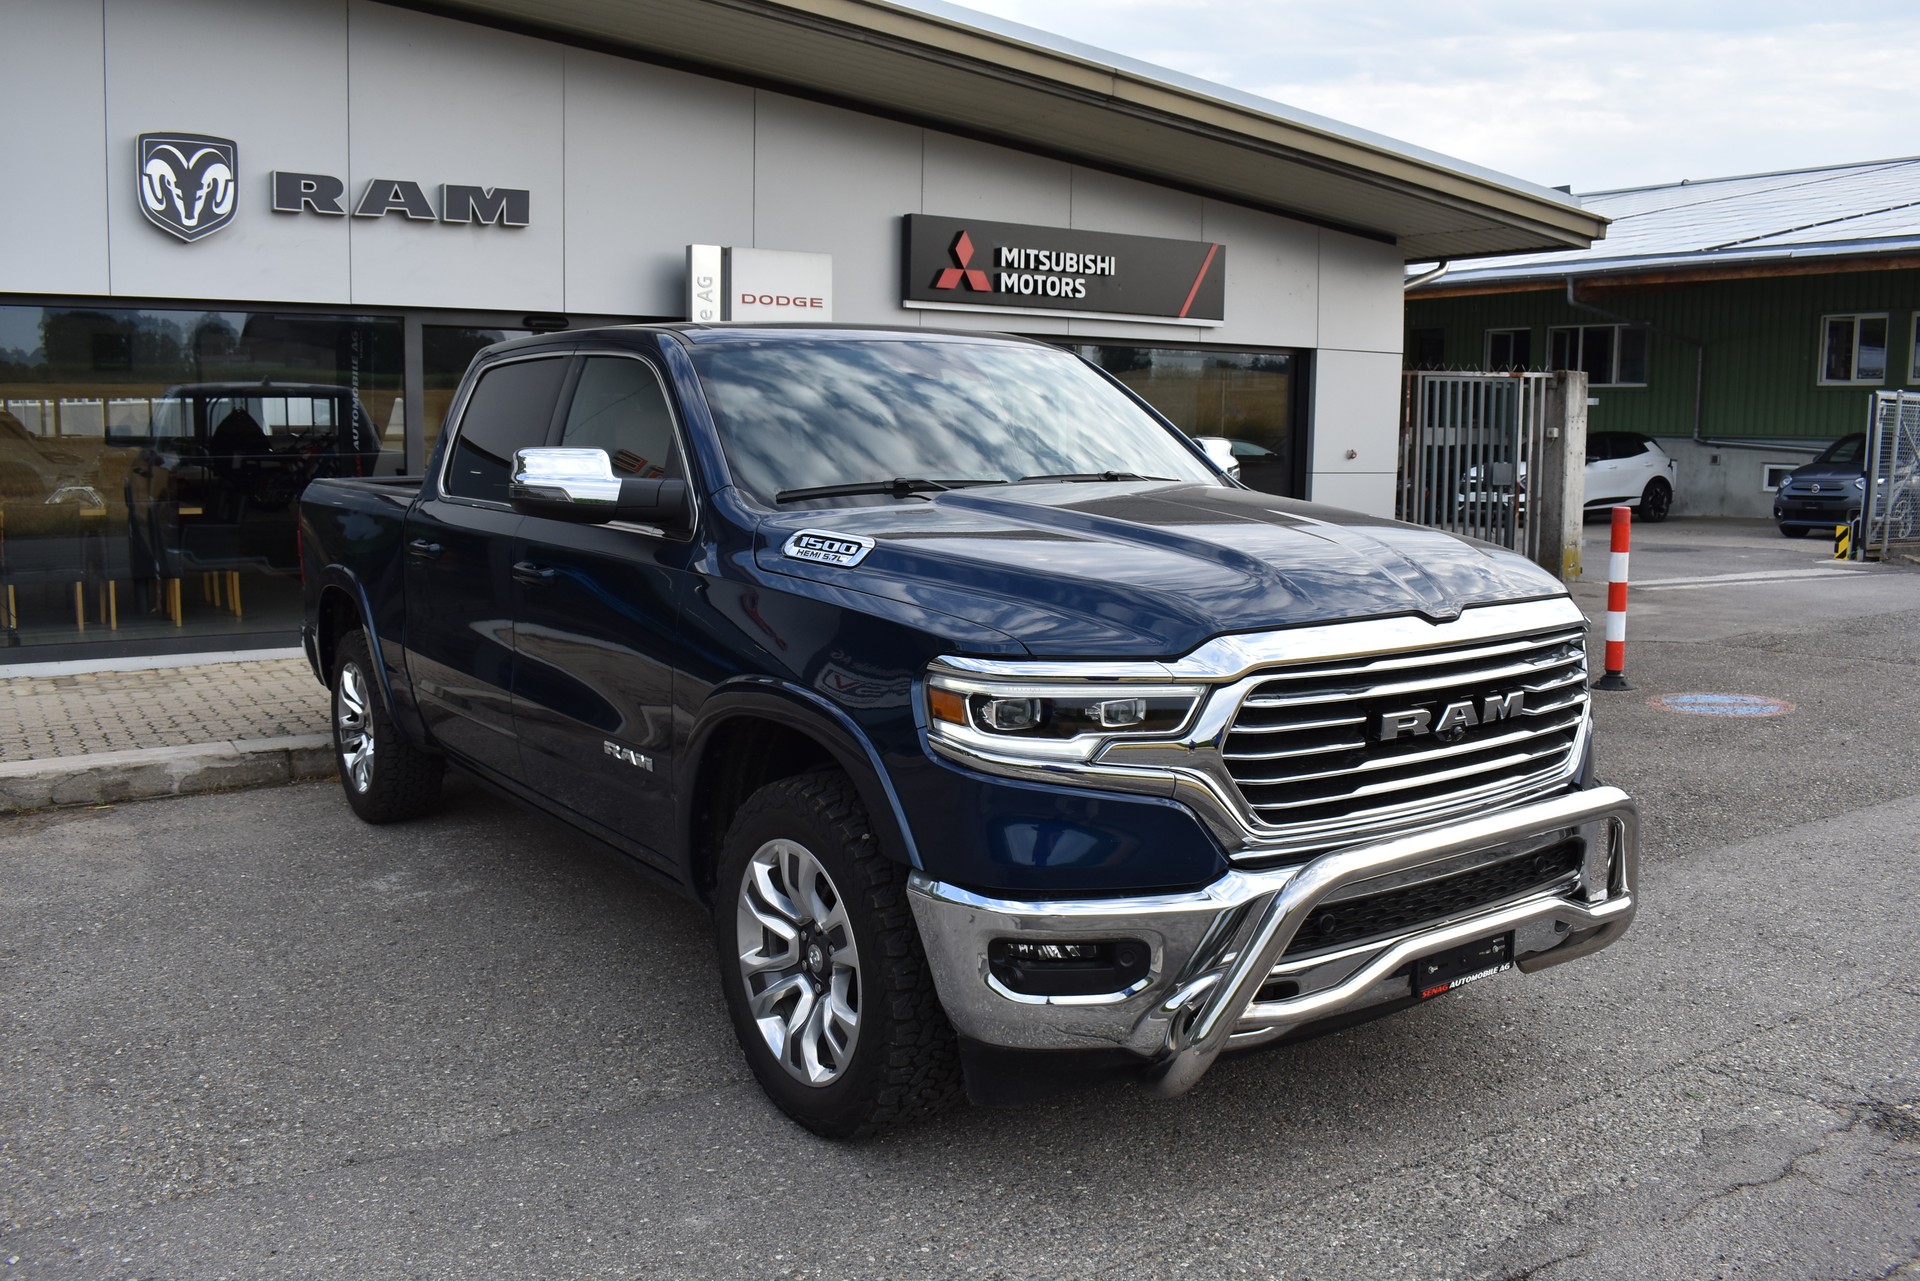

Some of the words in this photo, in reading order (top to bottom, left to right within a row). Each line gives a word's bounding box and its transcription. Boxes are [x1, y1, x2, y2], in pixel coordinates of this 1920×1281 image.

[271, 170, 529, 226] RAM
[1001, 246, 1116, 276] MITSUBISHI
[697, 276, 713, 303] AG
[1000, 272, 1086, 298] MOTORS
[742, 293, 823, 308] DODGE
[352, 355, 360, 450] AUTOMOBILE
[796, 549, 820, 558] HEMI
[800, 536, 859, 555] 1500
[1380, 690, 1524, 741] RAM
[604, 740, 653, 772] RAM
[1449, 966, 1498, 988] AUTOMOBILE
[1499, 962, 1510, 972] AG
